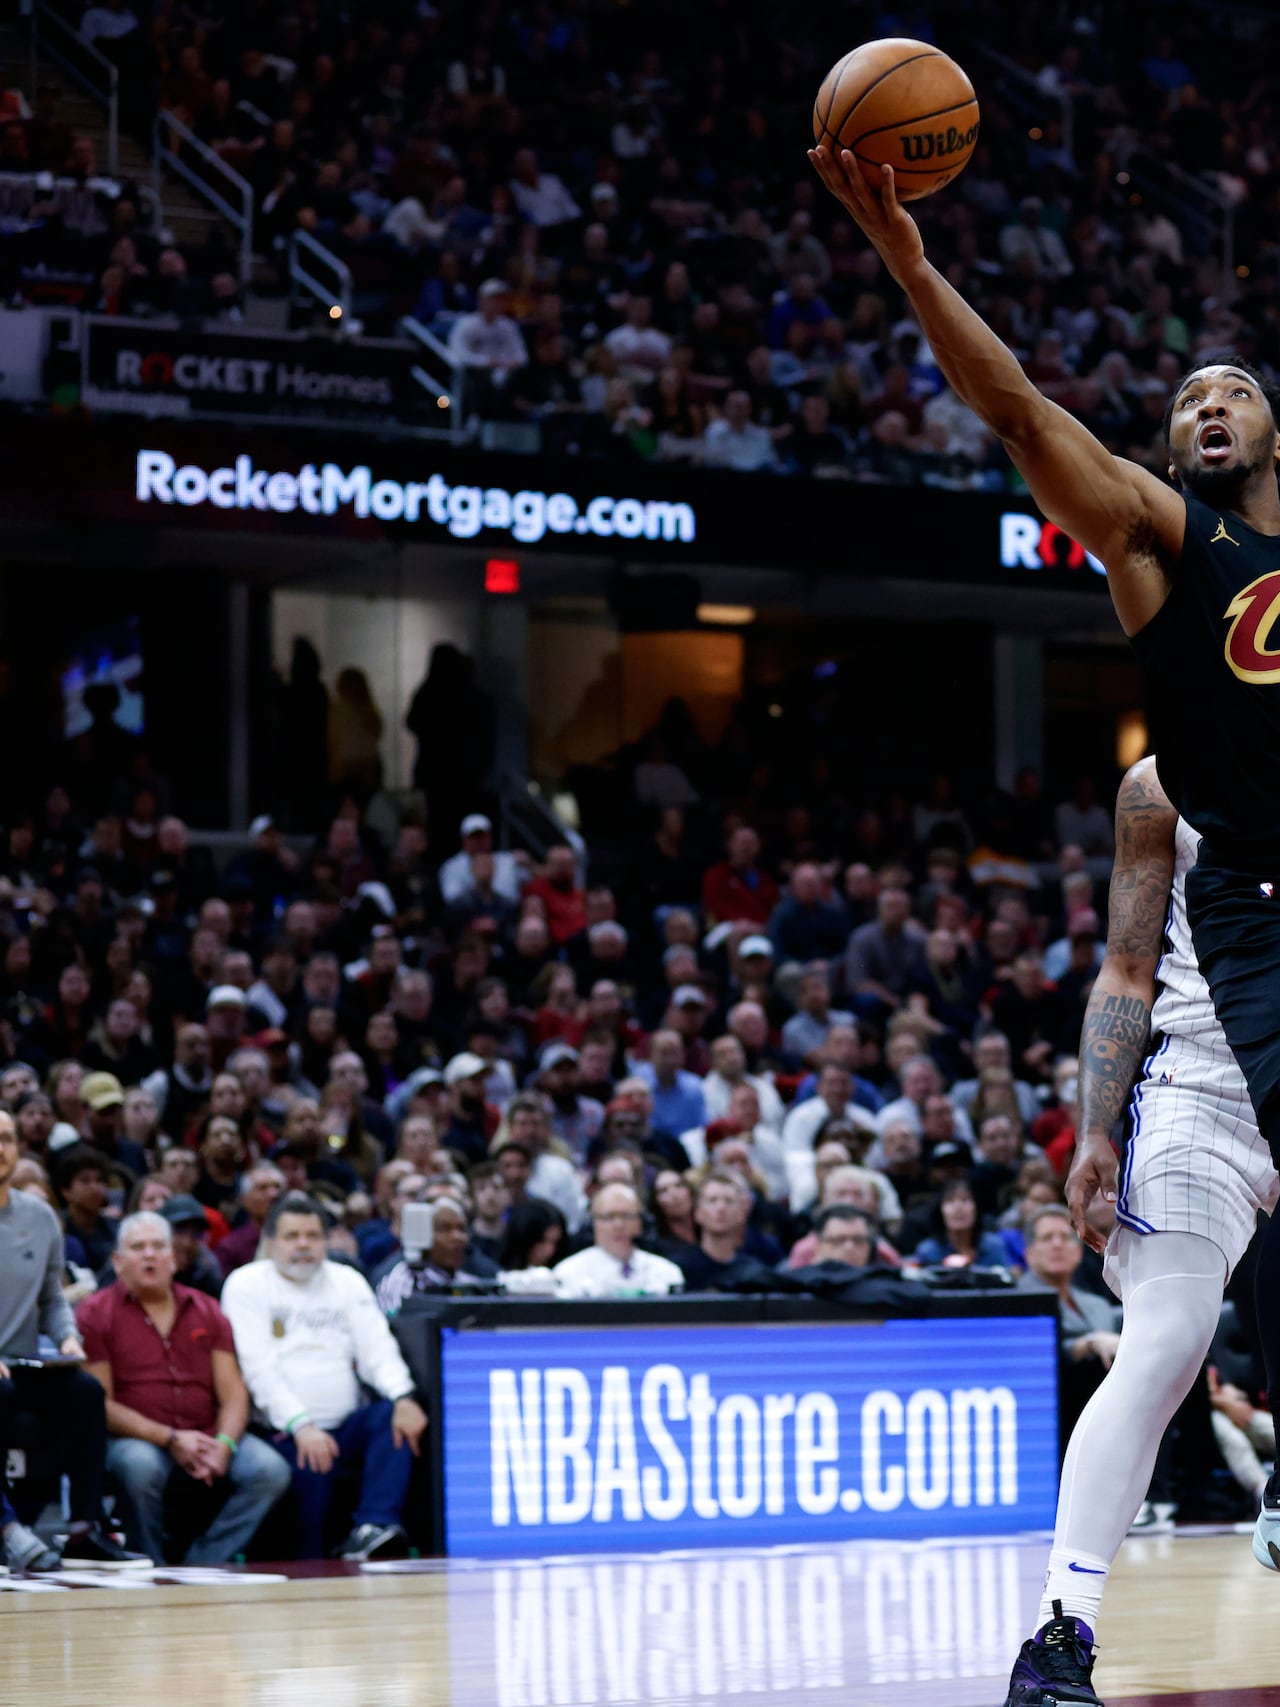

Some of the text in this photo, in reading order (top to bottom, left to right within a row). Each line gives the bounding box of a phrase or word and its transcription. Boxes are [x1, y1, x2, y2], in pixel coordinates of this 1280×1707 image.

[115, 349, 393, 406] ROCKET Homes
[135, 448, 697, 543] RocketMortgage.com
[489, 1363, 1019, 1527] NBAStore.com
